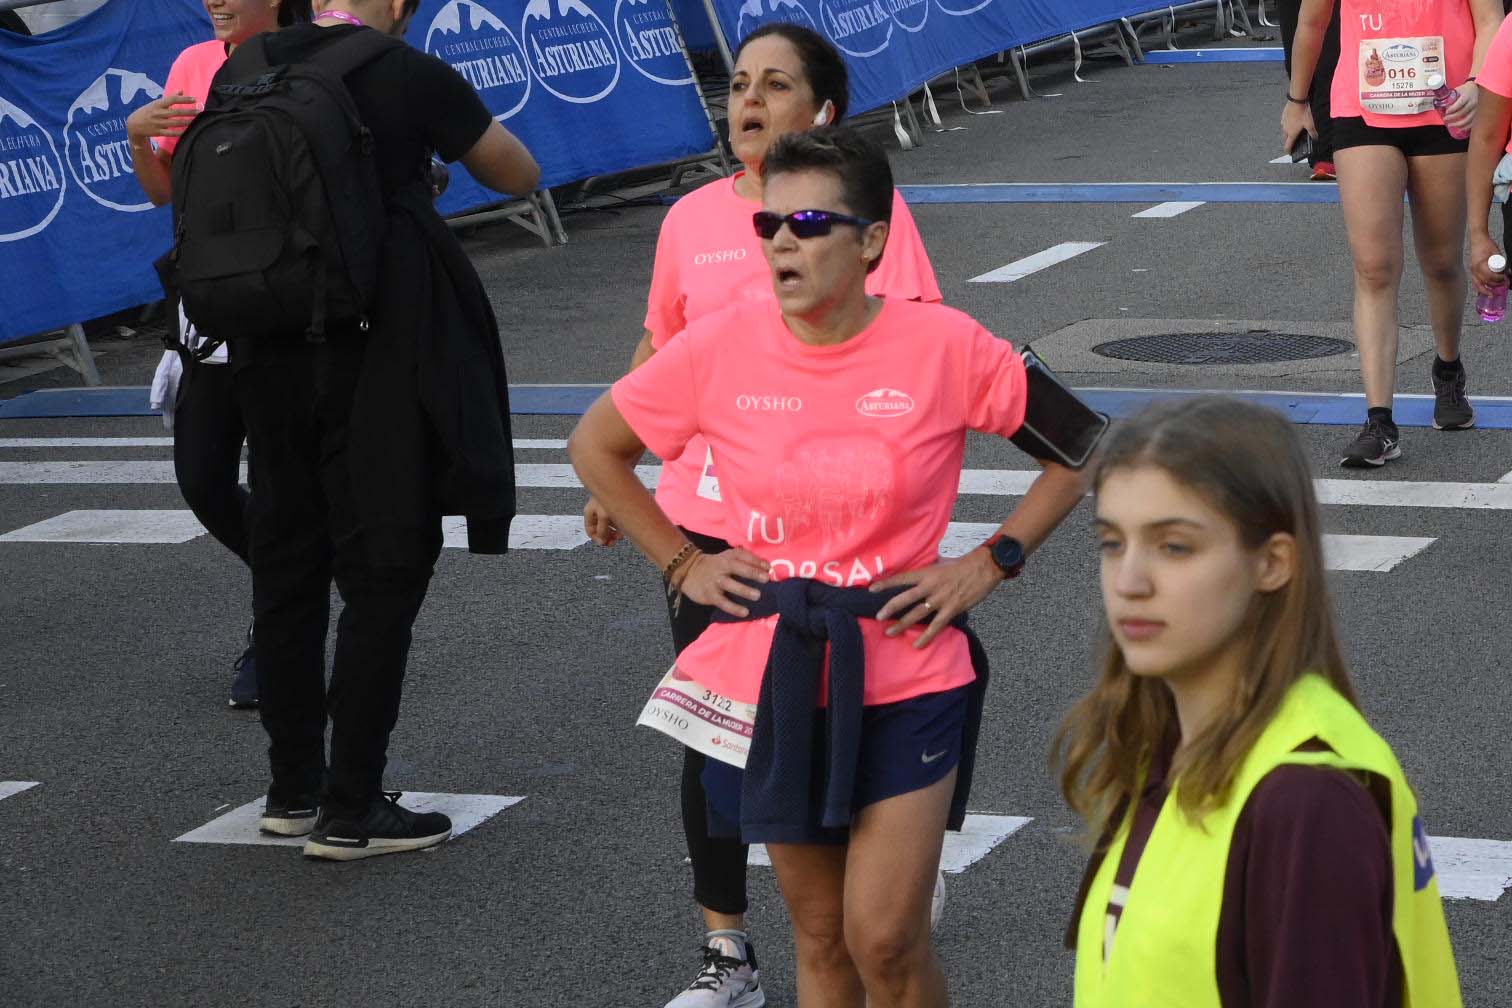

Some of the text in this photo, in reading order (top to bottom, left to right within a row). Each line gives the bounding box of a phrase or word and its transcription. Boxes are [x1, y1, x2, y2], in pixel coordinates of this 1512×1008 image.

[1360, 14, 1383, 31] TU
[531, 33, 615, 78] ASTURIANA
[1389, 68, 1416, 79] 016
[694, 248, 746, 265] OYSHO
[736, 394, 802, 412] OYSHO
[860, 400, 911, 411] ASTURIANA
[748, 511, 785, 544] TU
[660, 690, 697, 712] CARRERA
[697, 708, 709, 719] DE
[711, 713, 722, 724] LA
[722, 718, 743, 732] MUJER
[702, 690, 732, 712] 3122
[648, 706, 689, 730] OYSHO
